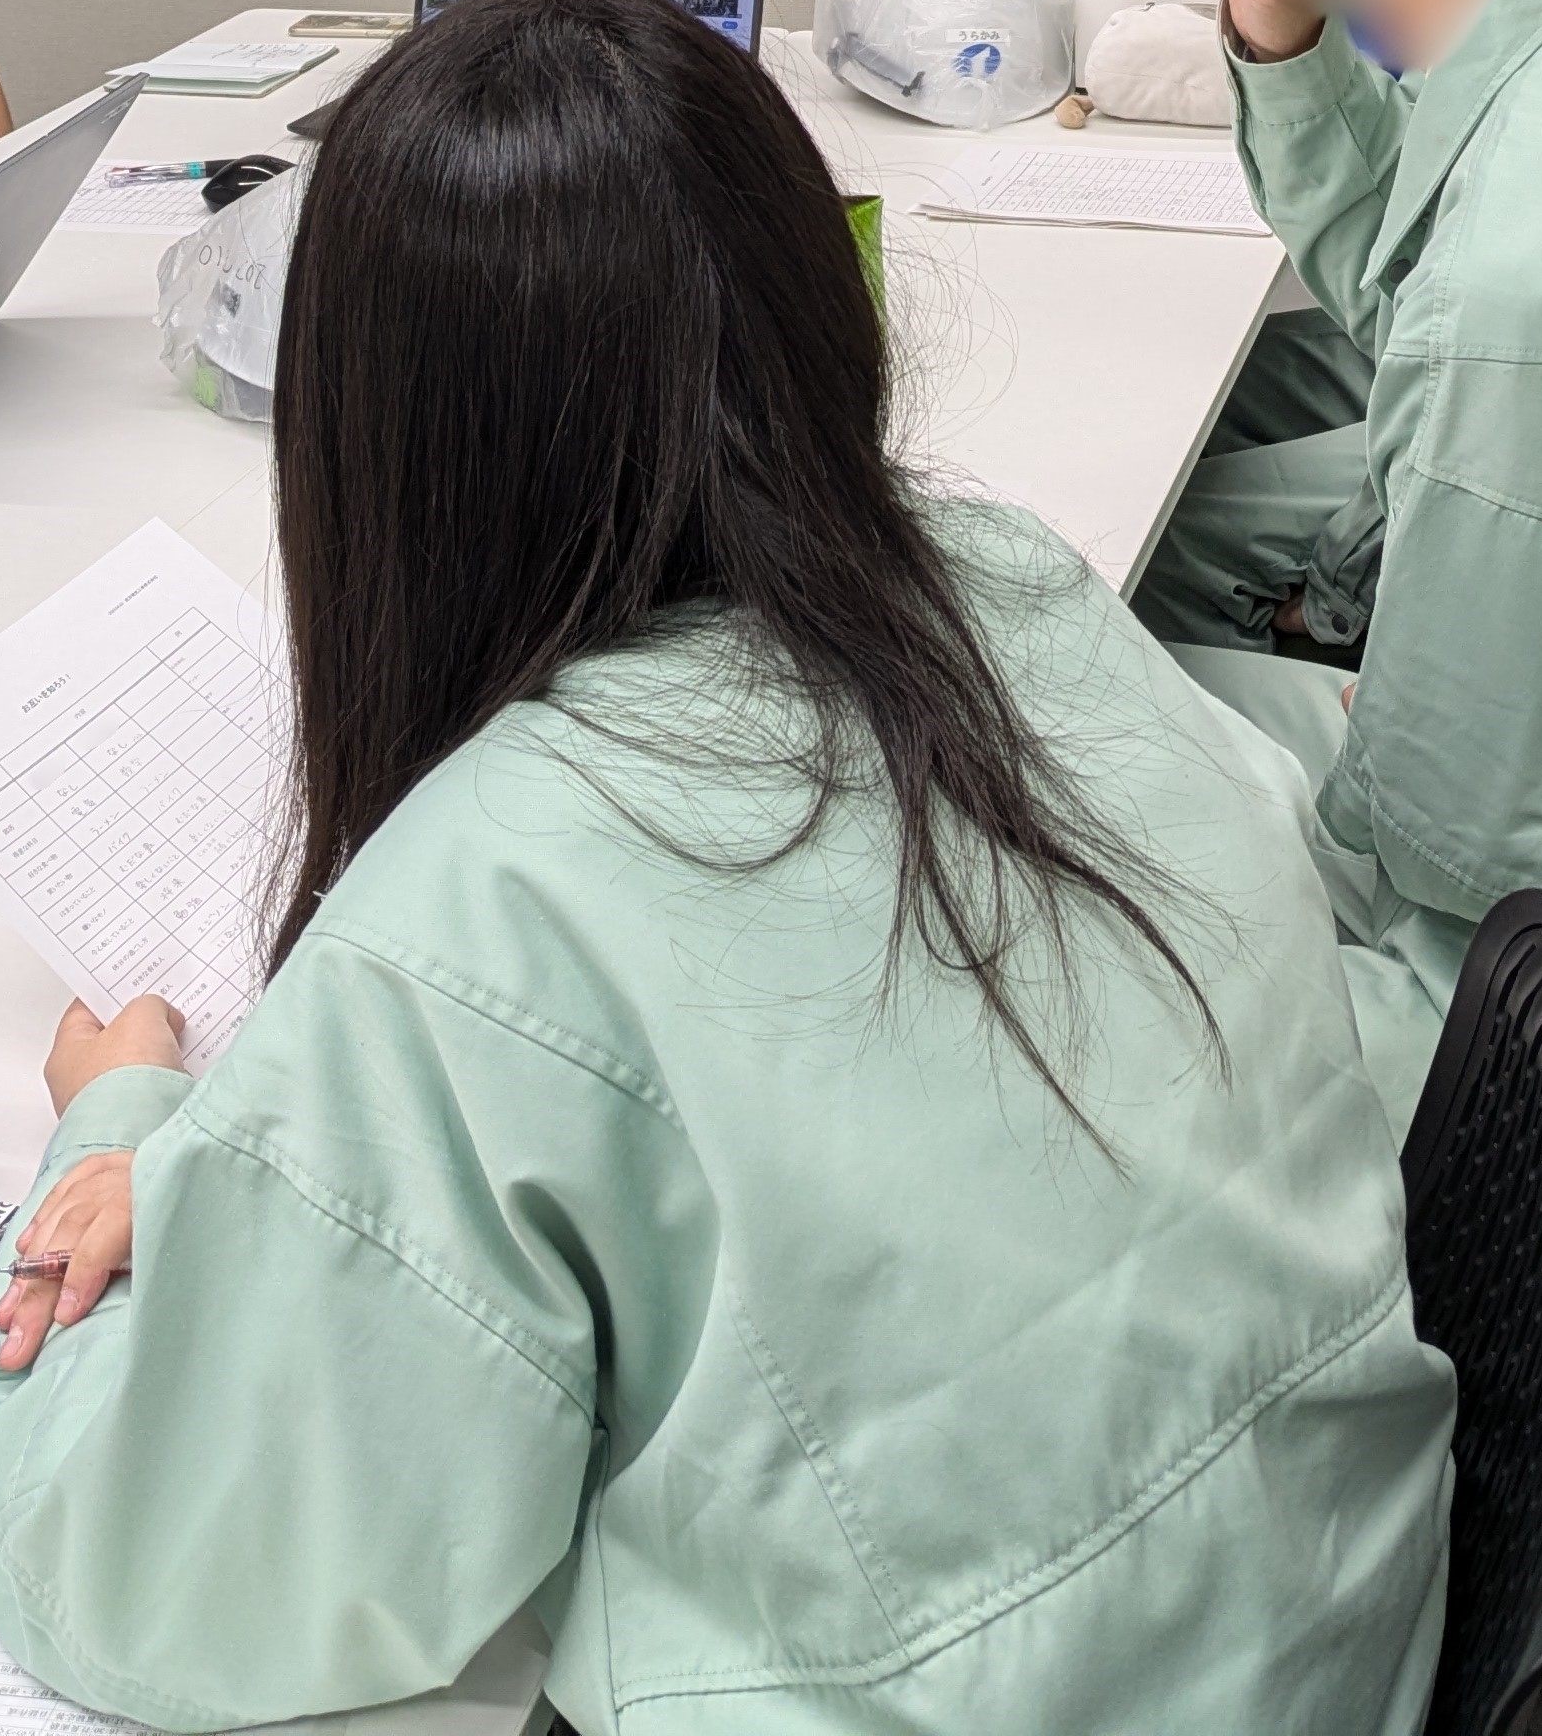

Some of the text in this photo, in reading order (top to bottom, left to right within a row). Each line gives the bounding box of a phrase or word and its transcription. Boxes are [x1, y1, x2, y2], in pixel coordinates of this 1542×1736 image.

[959, 31, 1000, 41] うらかみ
[155, 786, 182, 811] バイク
[90, 810, 120, 836] ラーメン
[106, 831, 131, 854] バイク
